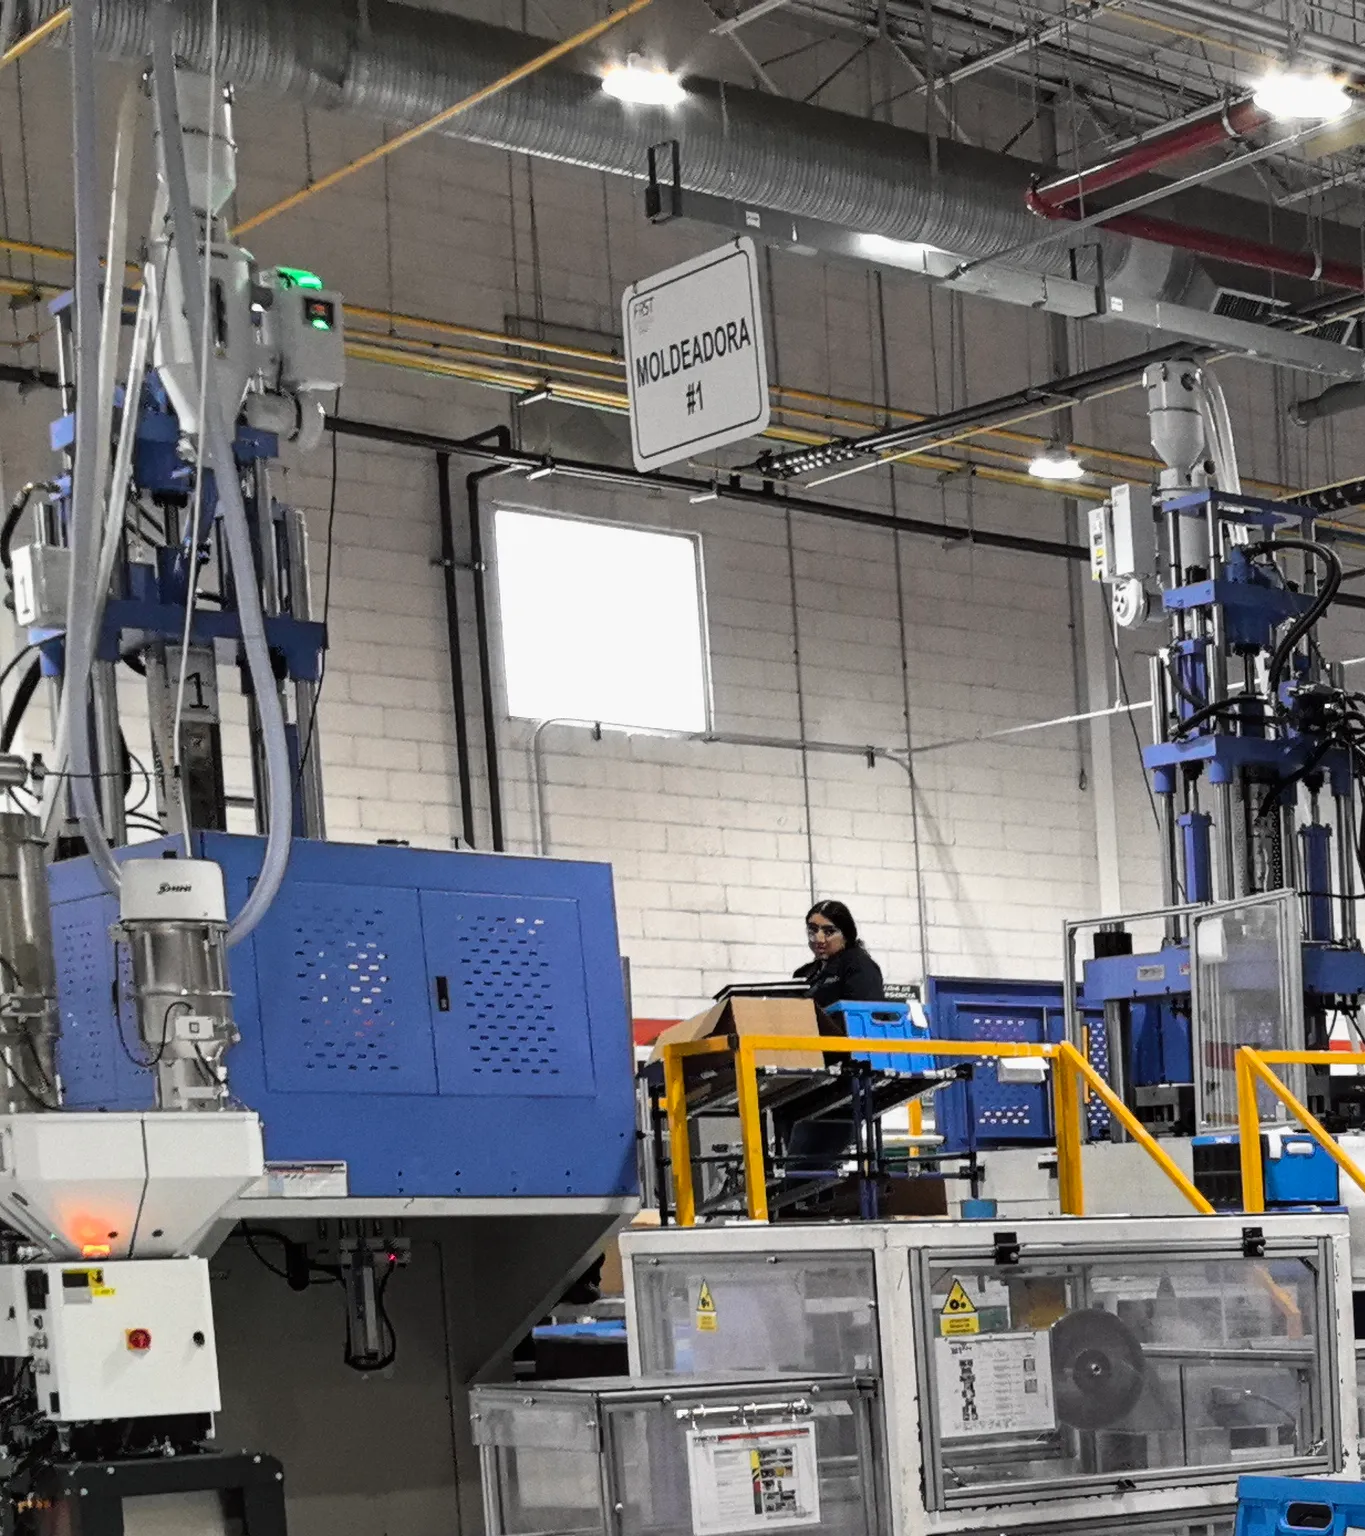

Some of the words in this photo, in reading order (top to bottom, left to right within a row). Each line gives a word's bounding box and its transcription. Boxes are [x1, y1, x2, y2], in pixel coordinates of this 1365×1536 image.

[636, 317, 751, 388] MOLDEADORA
[686, 380, 704, 415] #1
[186, 672, 210, 709] 1
